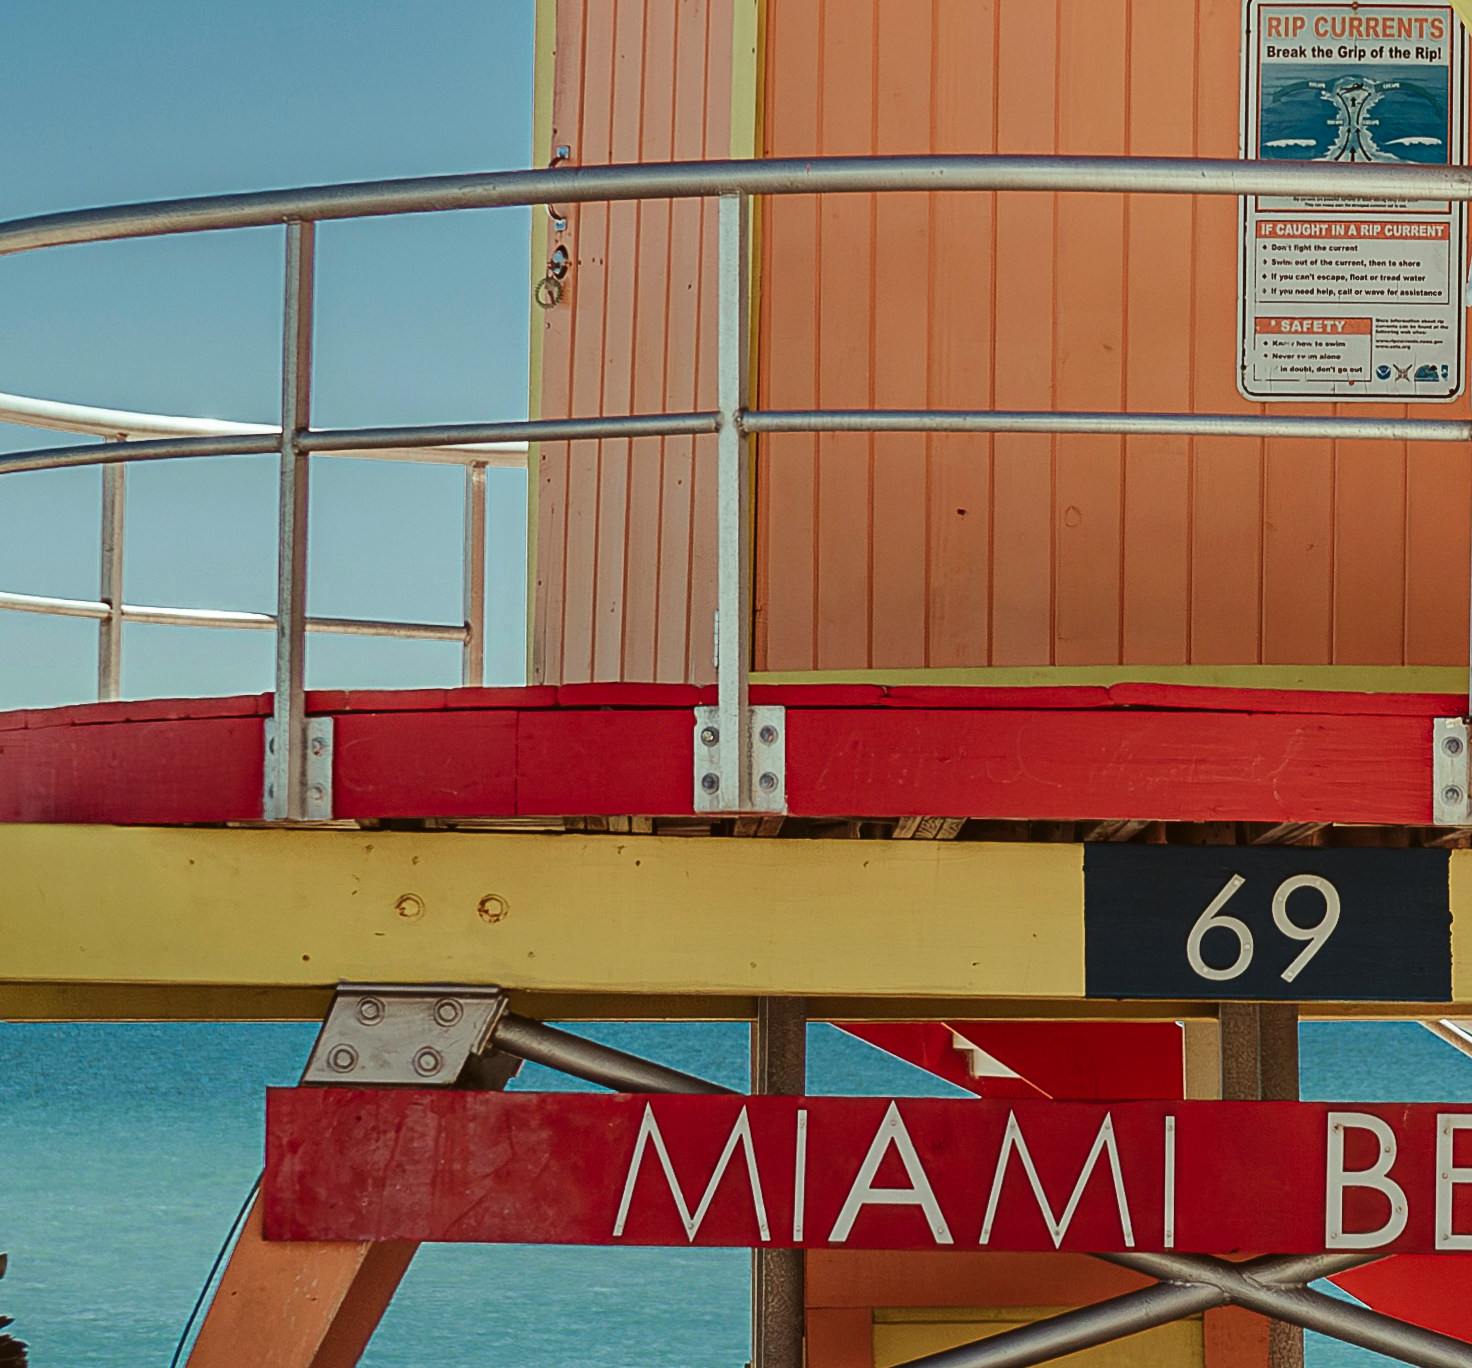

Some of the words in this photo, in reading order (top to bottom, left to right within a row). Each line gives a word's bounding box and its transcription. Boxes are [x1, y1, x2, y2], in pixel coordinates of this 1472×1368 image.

[1267, 16, 1305, 38] RIP
[1314, 16, 1444, 39] CURRENTS
[1267, 46, 1306, 58] Break
[1312, 46, 1333, 58] the
[1338, 46, 1366, 61] Grip
[1371, 46, 1384, 58] of
[1389, 47, 1410, 59] the
[1416, 47, 1441, 62] Rip!
[1262, 224, 1272, 235] IF
[1276, 224, 1328, 235] CAUGHT
[1332, 225, 1345, 236] IN
[1348, 225, 1357, 236] A
[1361, 225, 1381, 236] RIP
[1385, 225, 1444, 236] CURRENT
[1279, 274, 1293, 282] you
[1317, 274, 1348, 282] escape,
[1317, 289, 1335, 297] help,
[1281, 320, 1345, 332] SAFETY
[1187, 874, 1340, 982] 69
[612, 1100, 1175, 1249] MIAMI
